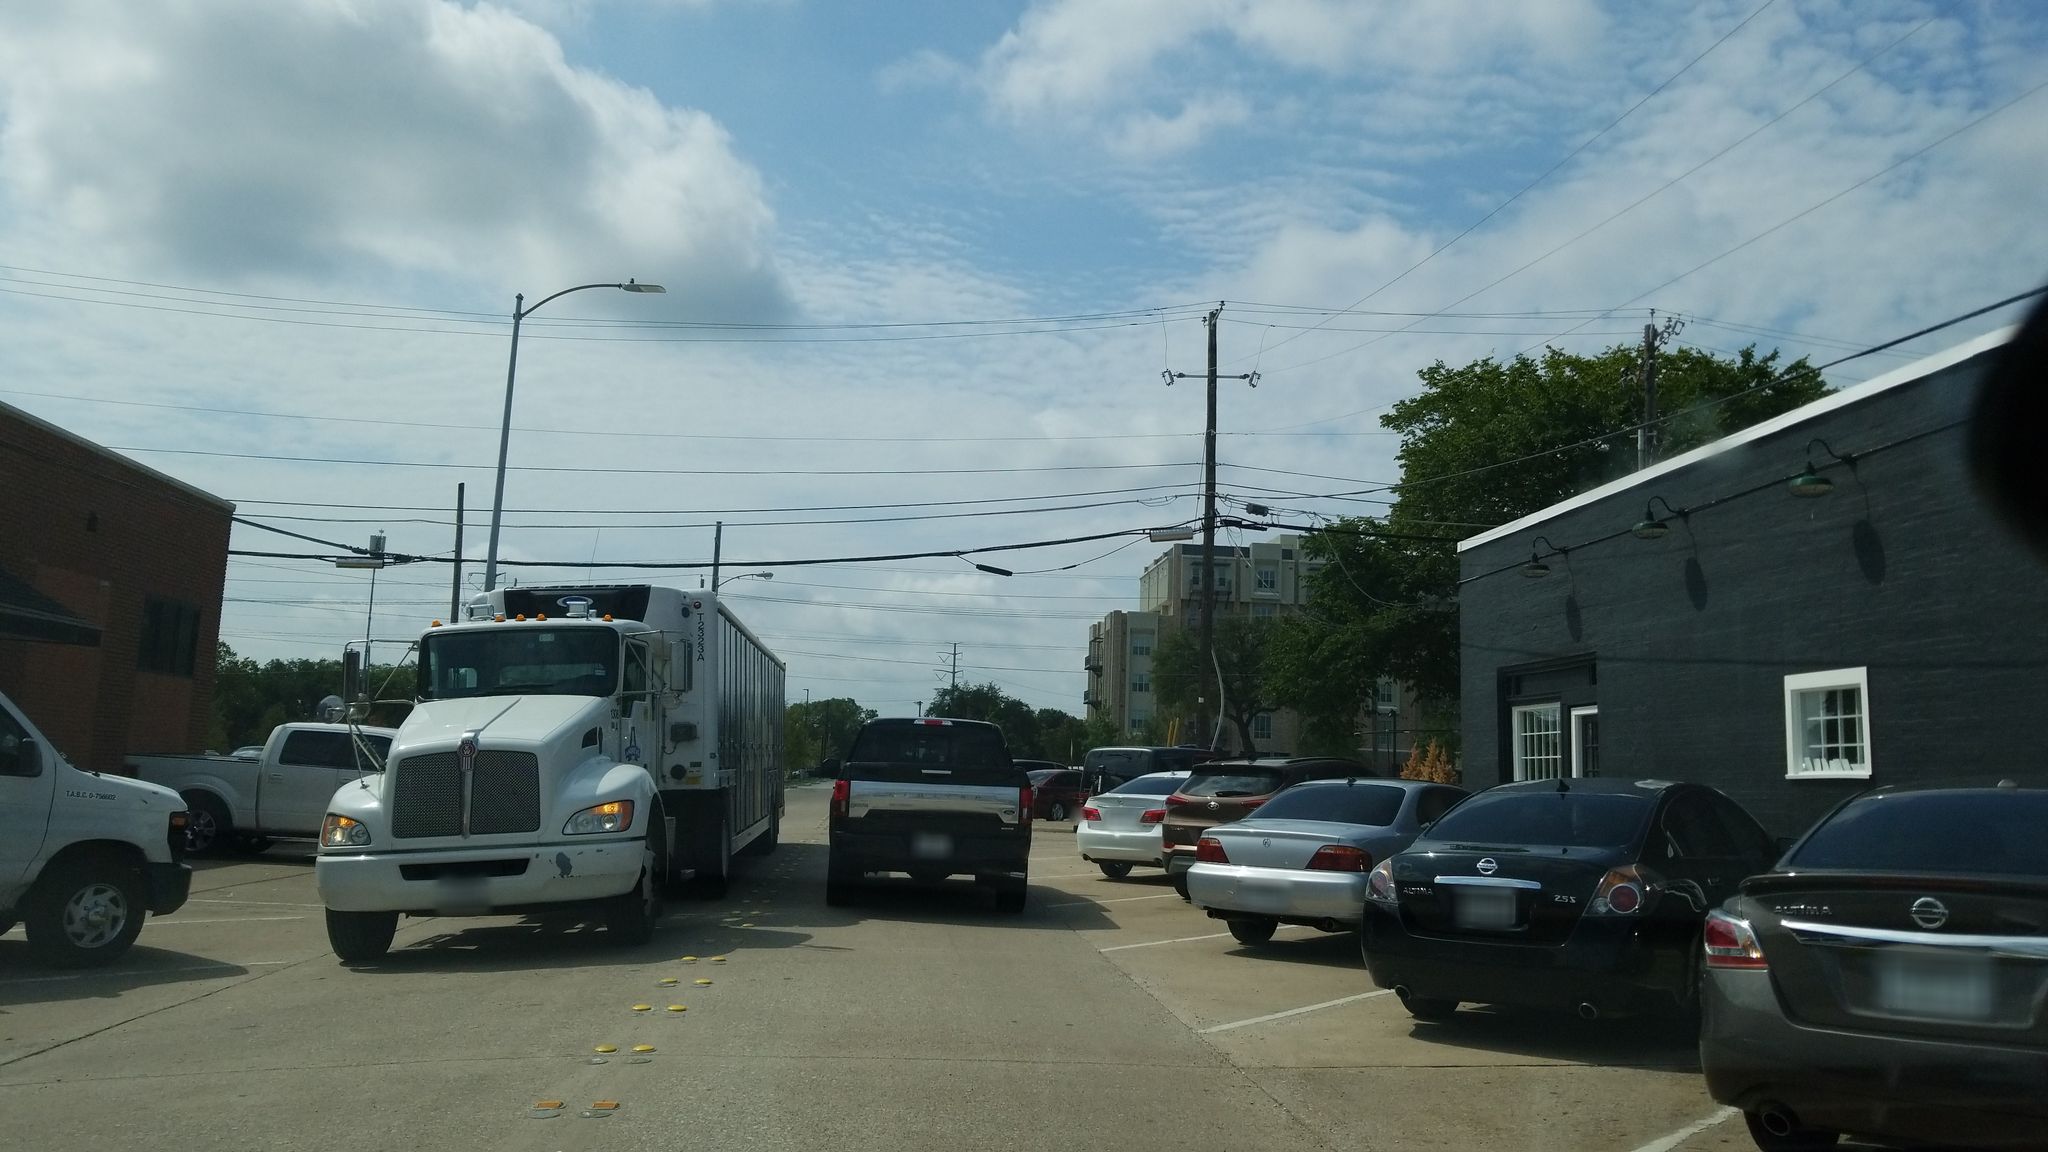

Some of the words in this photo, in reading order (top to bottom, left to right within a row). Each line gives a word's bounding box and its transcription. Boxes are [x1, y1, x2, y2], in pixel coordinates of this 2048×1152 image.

[697, 612, 705, 662] T2323A
[1402, 887, 1434, 896] ALTIMA
[1774, 904, 1833, 915] ALTIMA
